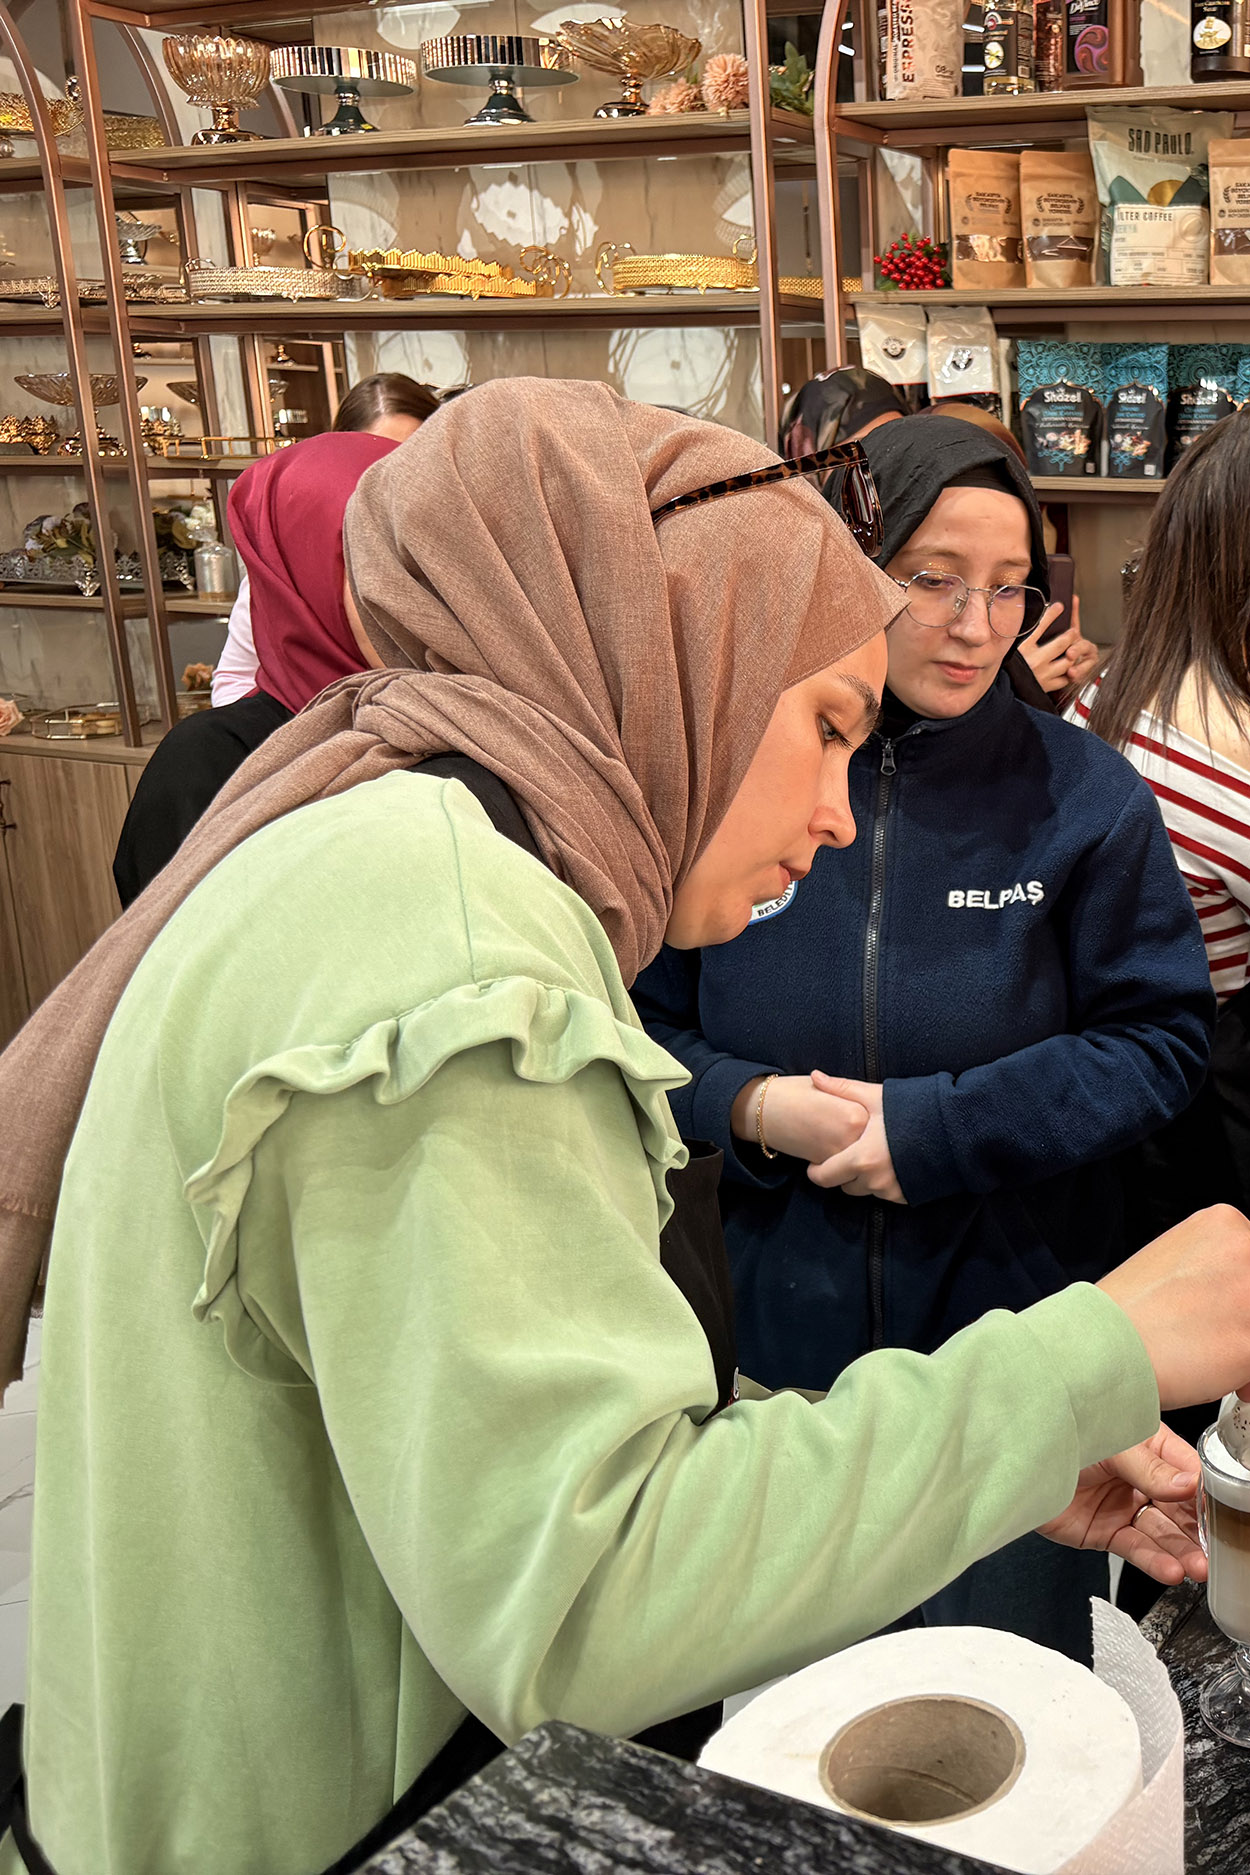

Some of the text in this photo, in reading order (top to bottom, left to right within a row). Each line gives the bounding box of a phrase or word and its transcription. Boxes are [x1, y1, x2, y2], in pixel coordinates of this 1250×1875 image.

[900, 0, 914, 82] ESPRESS
[1155, 133, 1192, 155] PAULO
[1117, 211, 1173, 221] ILTER COFFEE
[947, 879, 1045, 909] BELPAŞ
